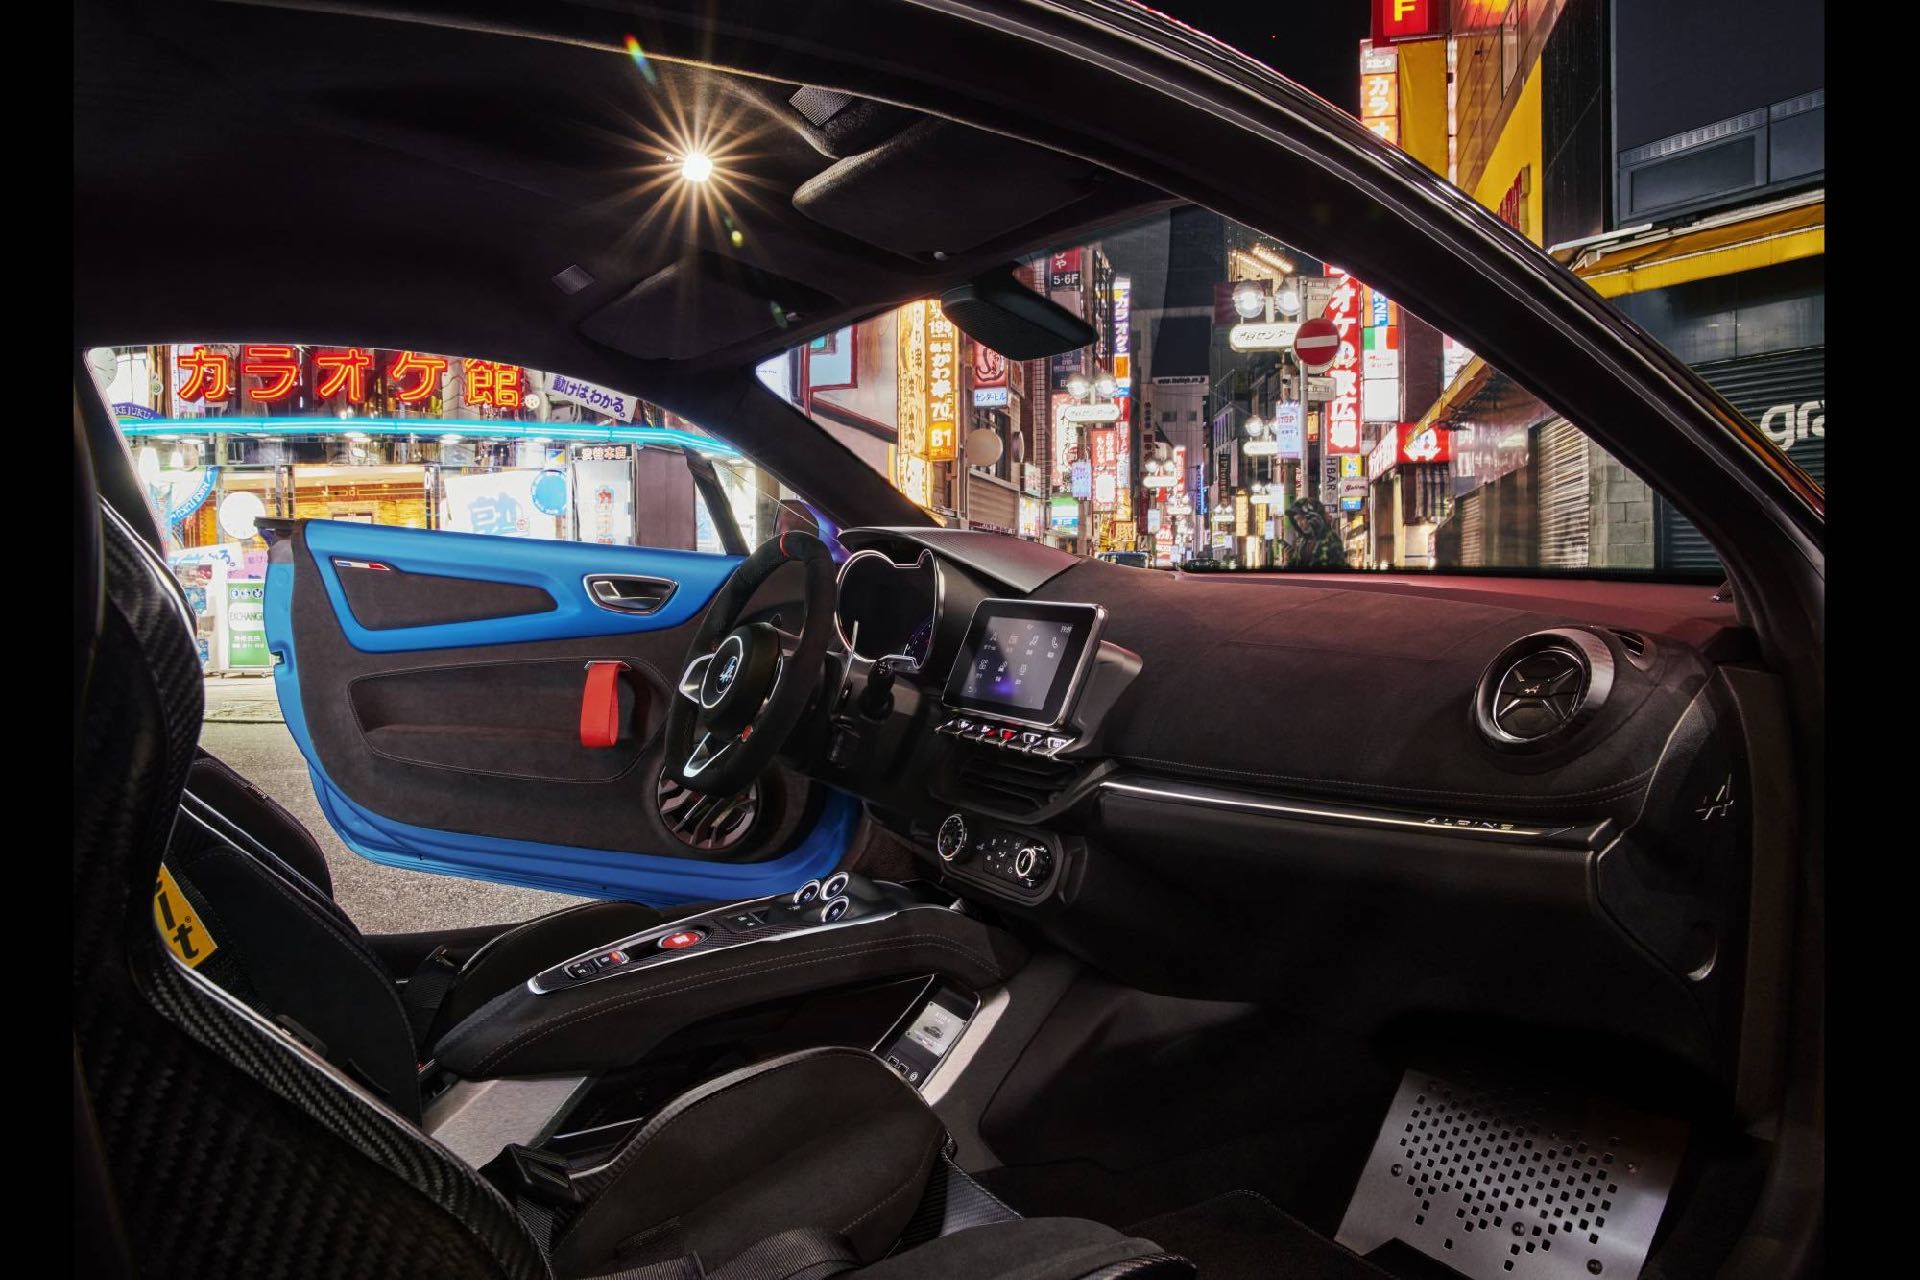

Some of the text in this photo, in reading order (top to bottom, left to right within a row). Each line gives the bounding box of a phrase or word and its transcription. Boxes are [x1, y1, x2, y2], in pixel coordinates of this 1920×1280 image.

[176, 346, 522, 408] カラオケ館
